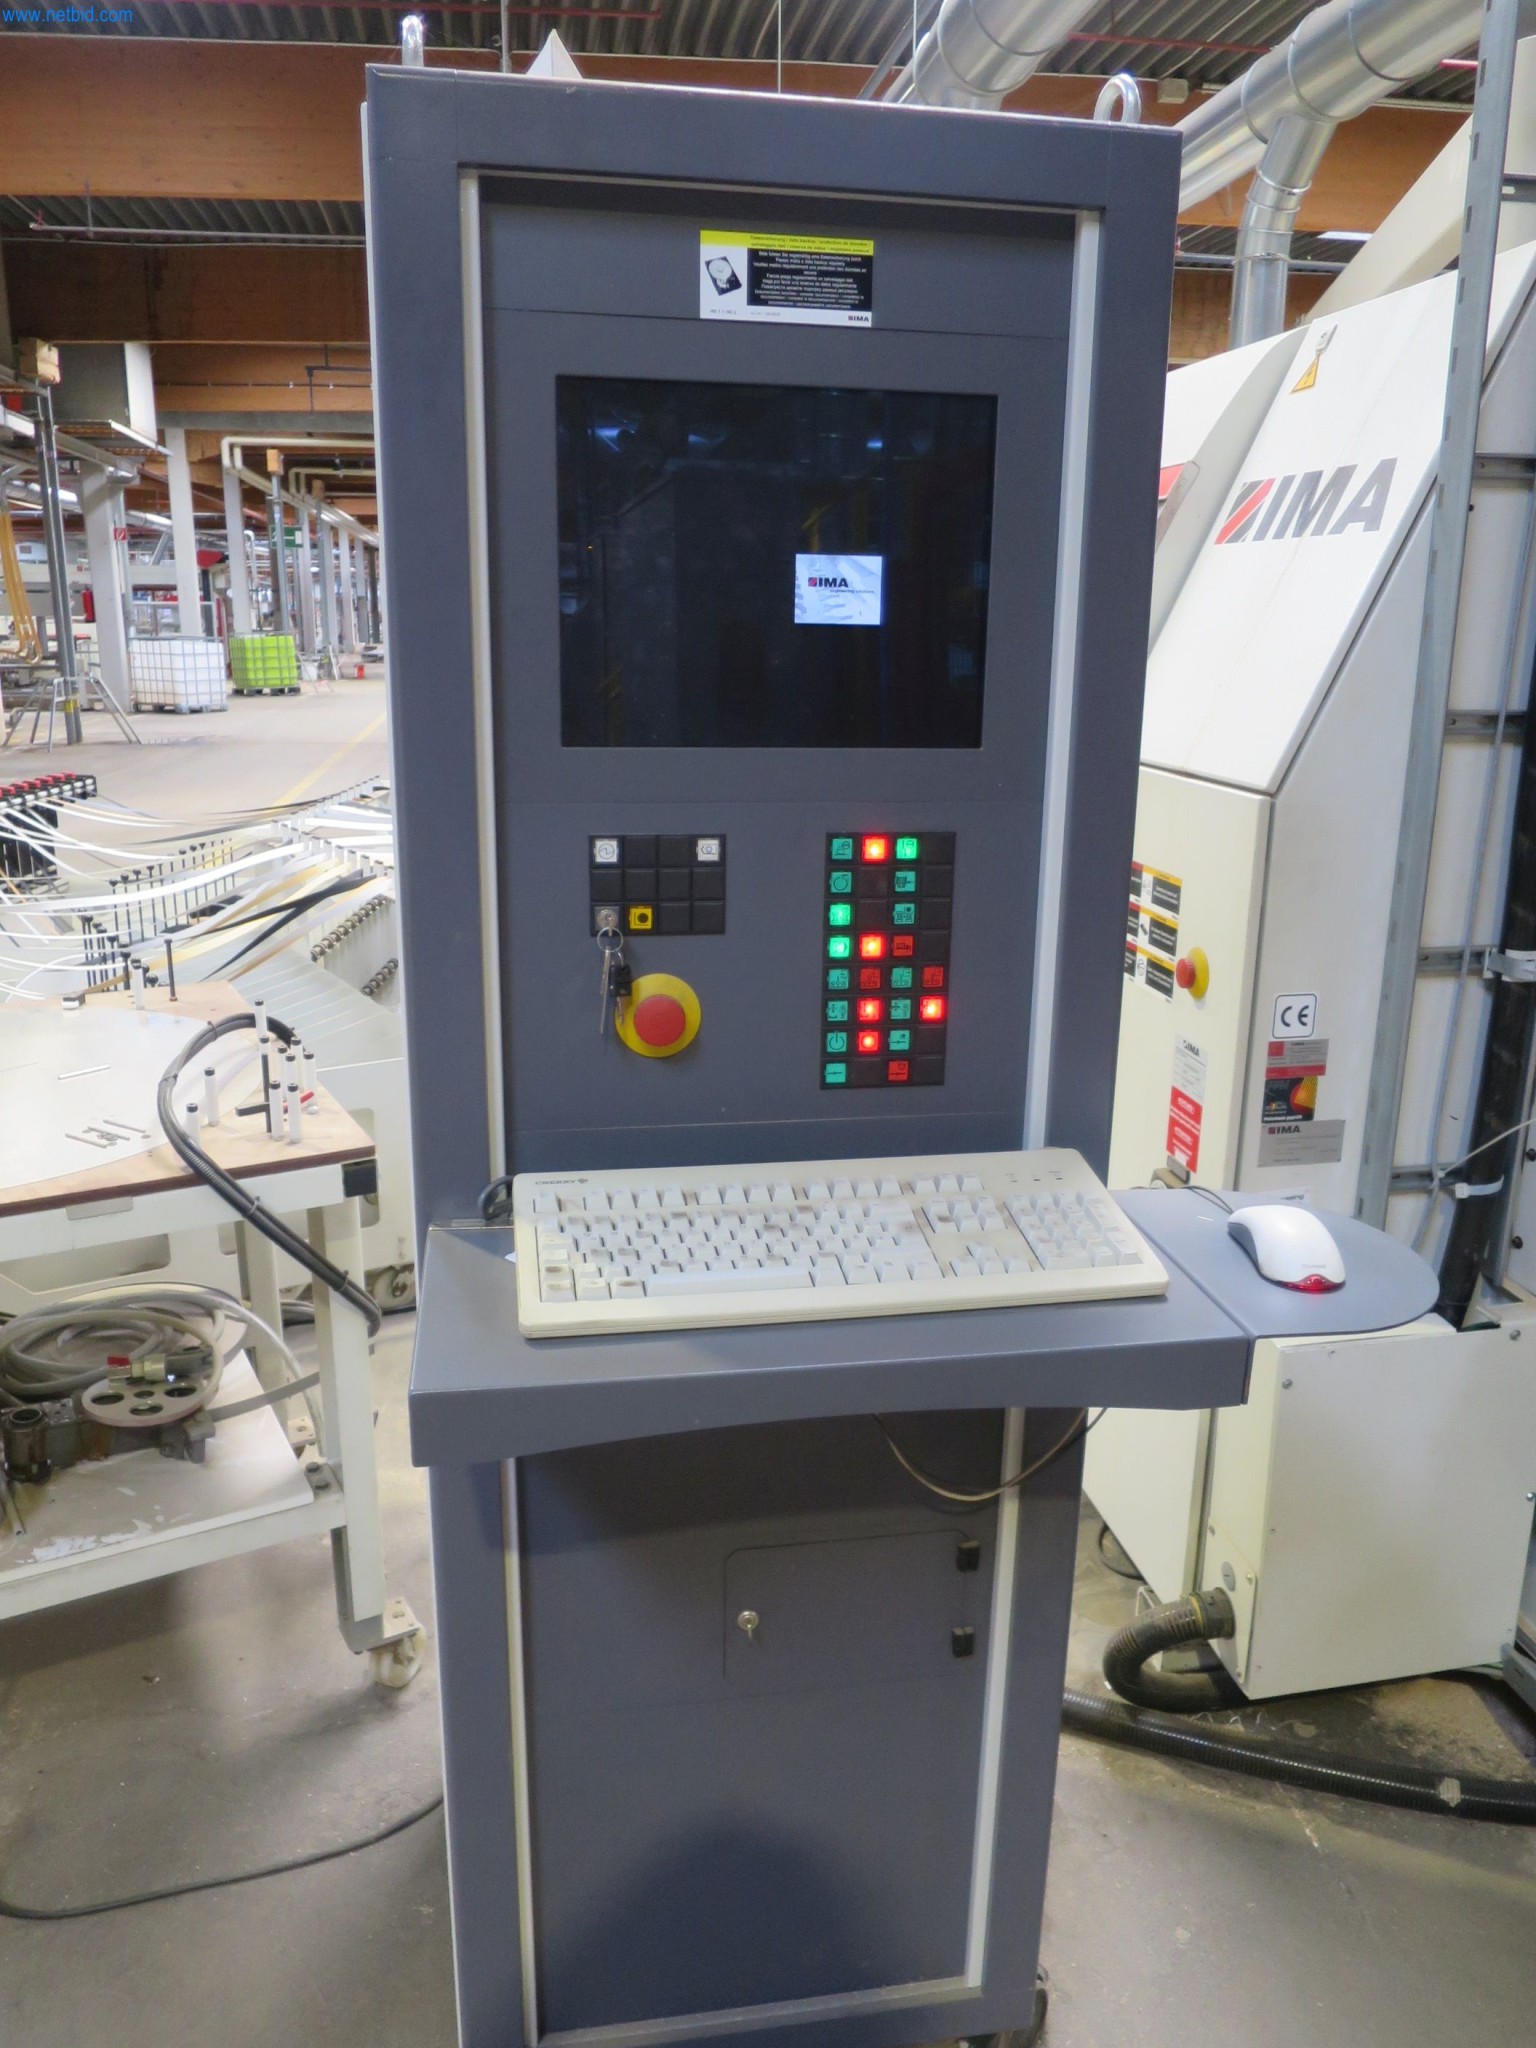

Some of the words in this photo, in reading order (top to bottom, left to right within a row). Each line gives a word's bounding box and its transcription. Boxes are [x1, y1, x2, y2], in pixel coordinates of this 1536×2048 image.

[1252, 457, 1398, 542] IMA
[818, 577, 848, 588] IMA
[1280, 1005, 1310, 1027] CE
[1276, 1125, 1301, 1135] IMA
